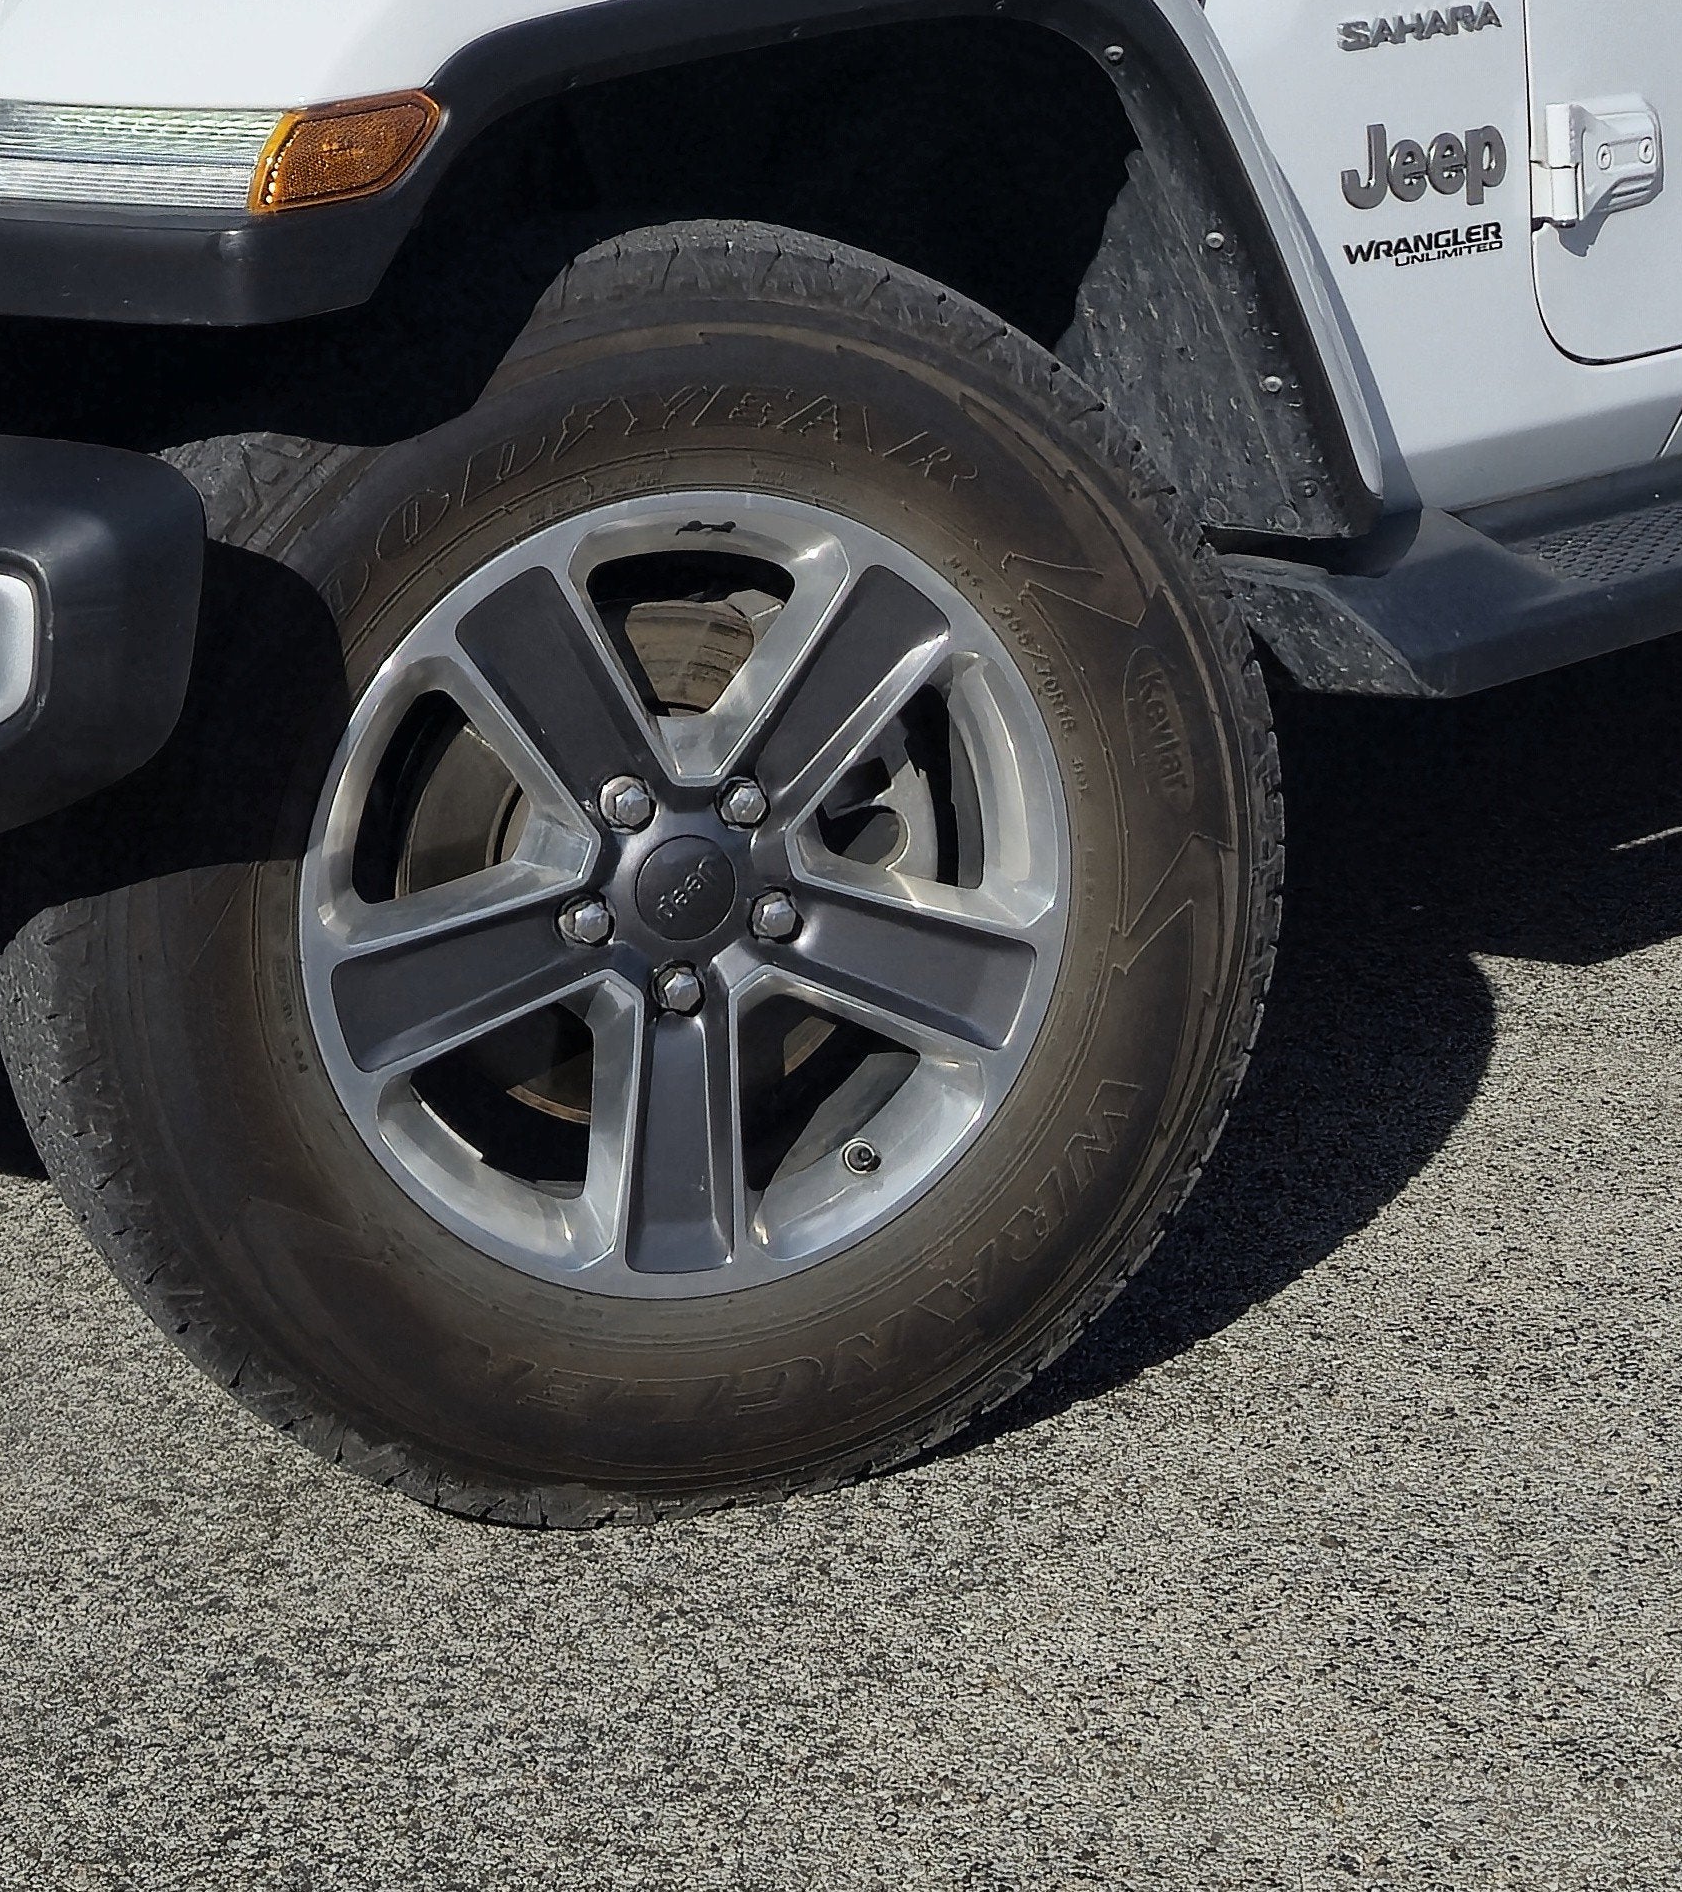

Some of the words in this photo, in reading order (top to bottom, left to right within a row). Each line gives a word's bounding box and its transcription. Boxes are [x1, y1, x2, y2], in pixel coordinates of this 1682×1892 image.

[1337, 1, 1502, 52] SAHARA
[1341, 123, 1507, 209] Jeep
[1343, 221, 1503, 265] WRANGLER
[1395, 240, 1503, 267] UNLIMITED
